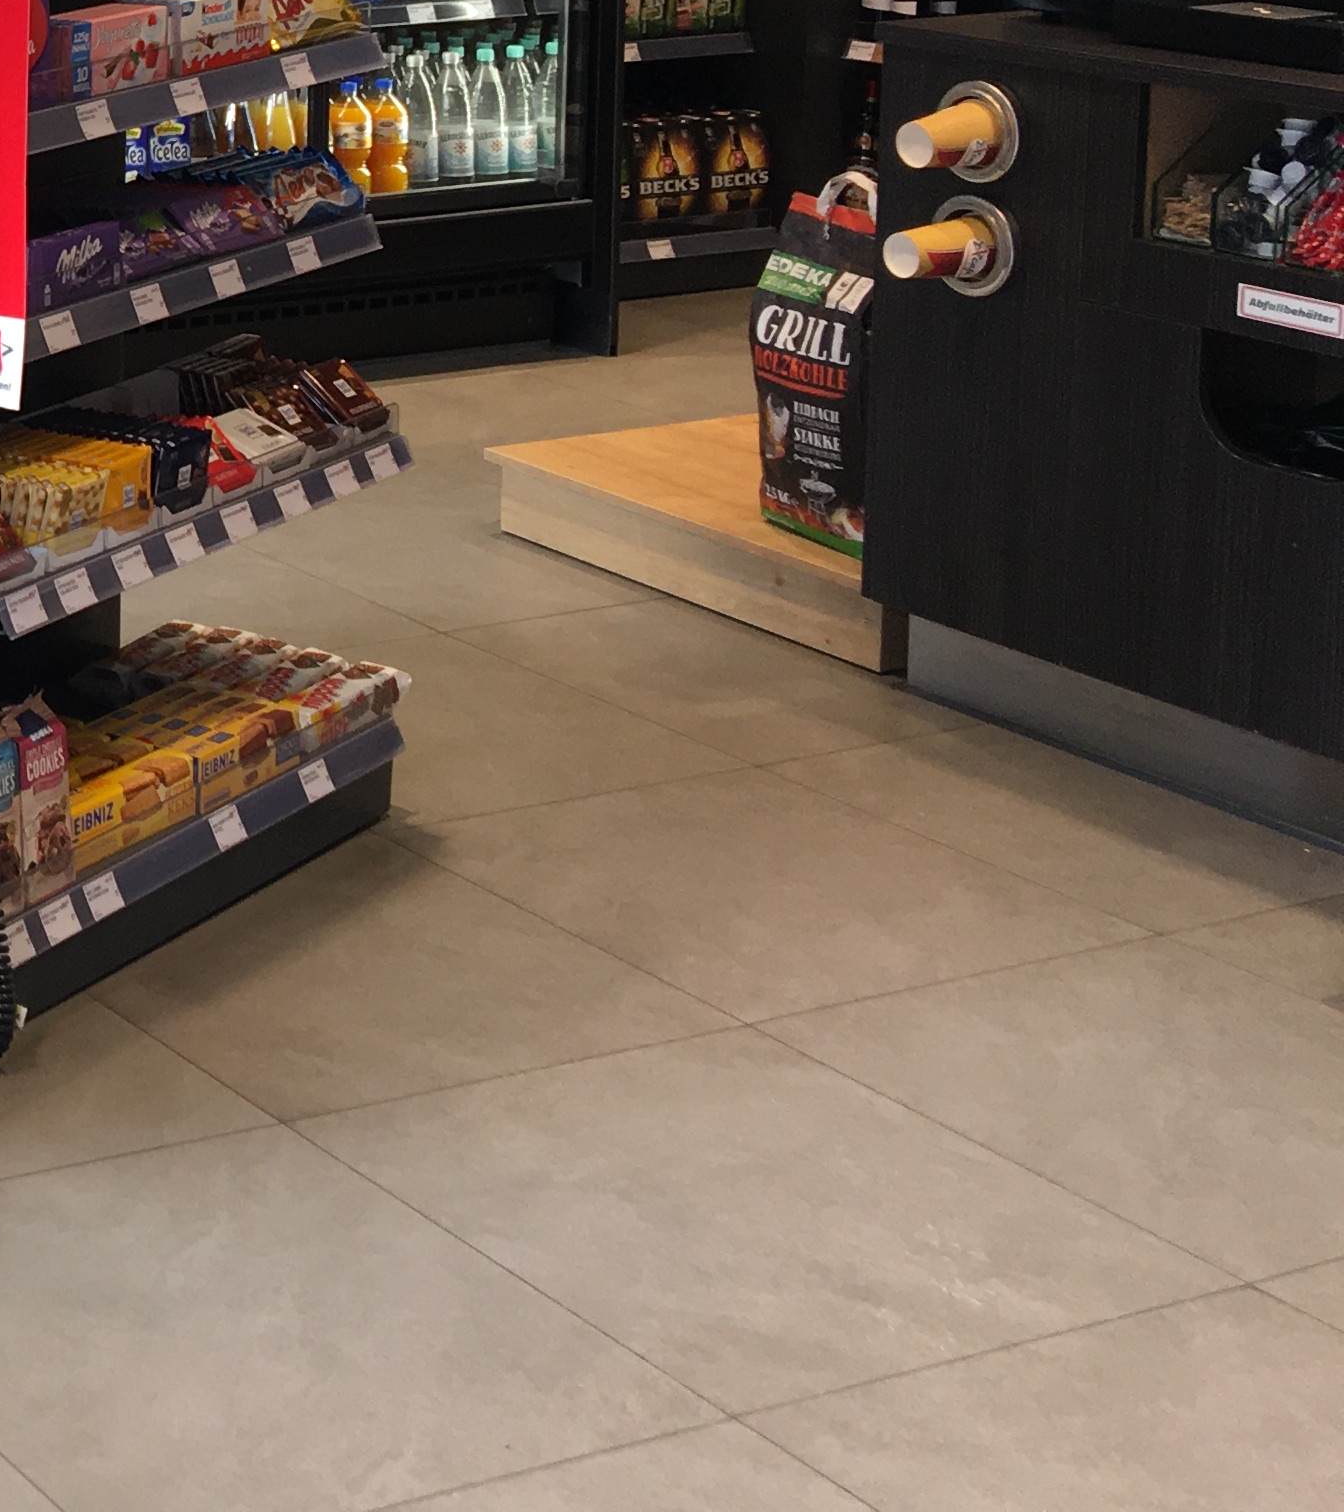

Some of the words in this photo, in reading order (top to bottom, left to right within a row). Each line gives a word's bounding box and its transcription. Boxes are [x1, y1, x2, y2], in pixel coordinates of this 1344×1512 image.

[77, 66, 89, 83] 10
[639, 176, 700, 198] BECK'S
[712, 170, 769, 190] BECK'S
[56, 235, 104, 274] Milka
[765, 253, 836, 288] EDEKA
[1248, 296, 1336, 327] Abfallbehälter
[755, 303, 851, 367] GRILL
[754, 344, 849, 391] HOLZKOHLE
[26, 746, 65, 782] COOKIES
